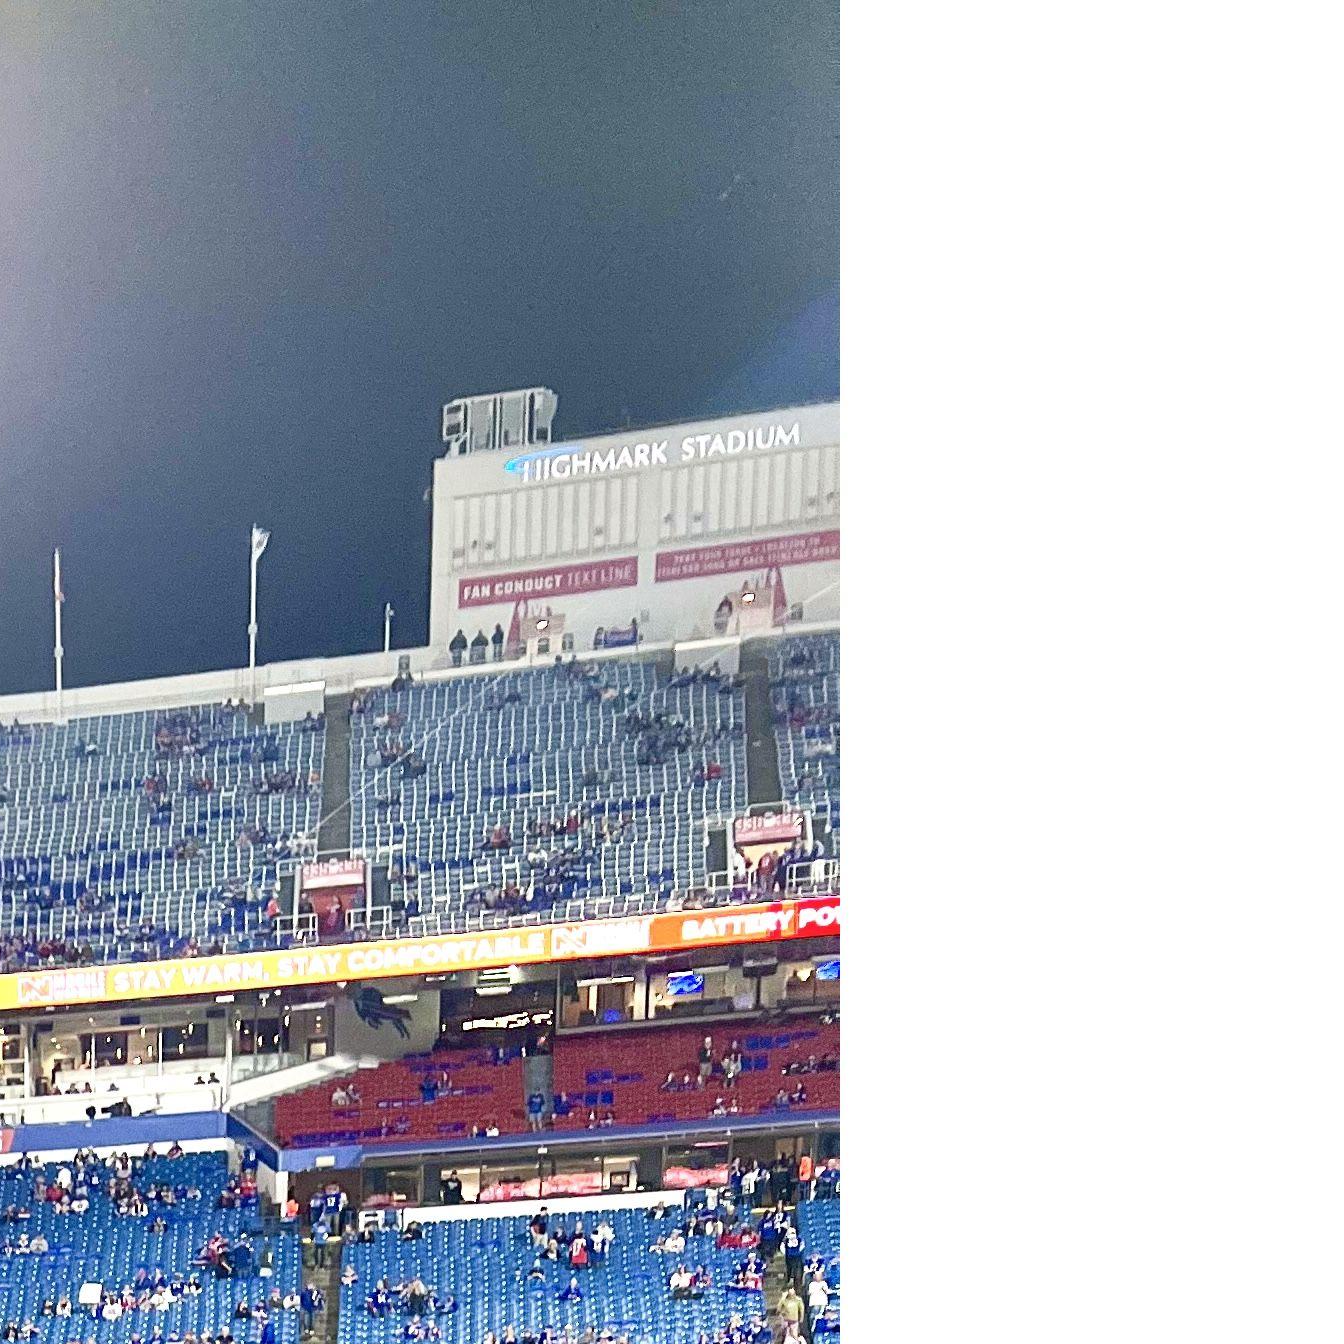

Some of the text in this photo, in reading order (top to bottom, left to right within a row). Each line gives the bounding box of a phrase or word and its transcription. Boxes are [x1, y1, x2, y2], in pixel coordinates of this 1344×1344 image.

[521, 423, 802, 482] HIGHMARK STADIUM
[463, 583, 491, 600] FAN
[494, 574, 563, 595] CONDUCT
[682, 909, 795, 940] BATTERY
[113, 967, 178, 993] STAY
[277, 953, 342, 977] STAY
[347, 932, 545, 972] COMFORTABLE
